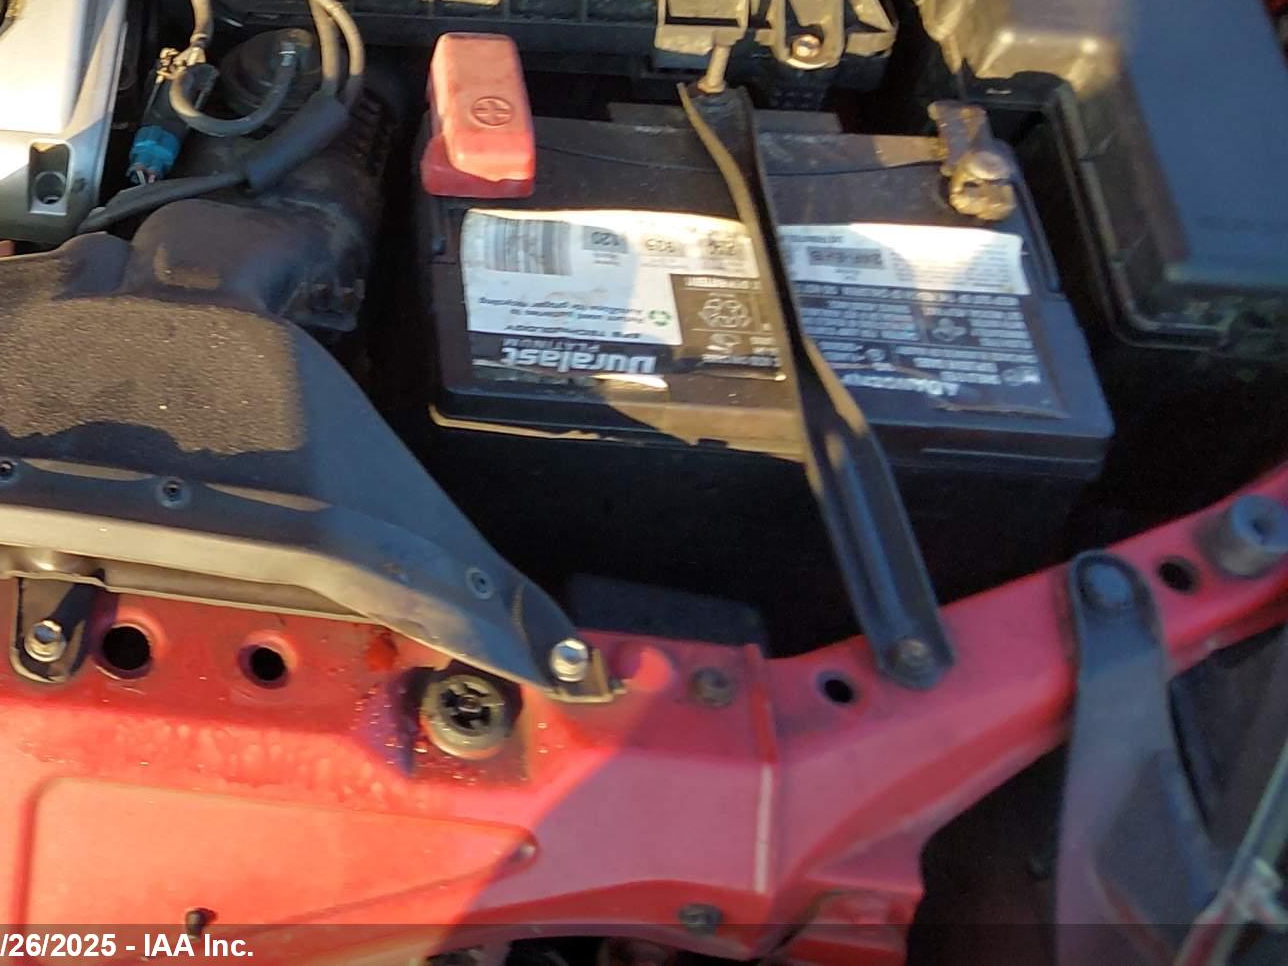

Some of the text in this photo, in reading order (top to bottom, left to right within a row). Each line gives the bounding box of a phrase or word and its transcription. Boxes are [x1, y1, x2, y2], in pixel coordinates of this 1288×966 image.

[505, 324, 606, 337] TECHNOLOGY
[502, 337, 601, 352] PLATINUM
[501, 346, 657, 374] Duralast
